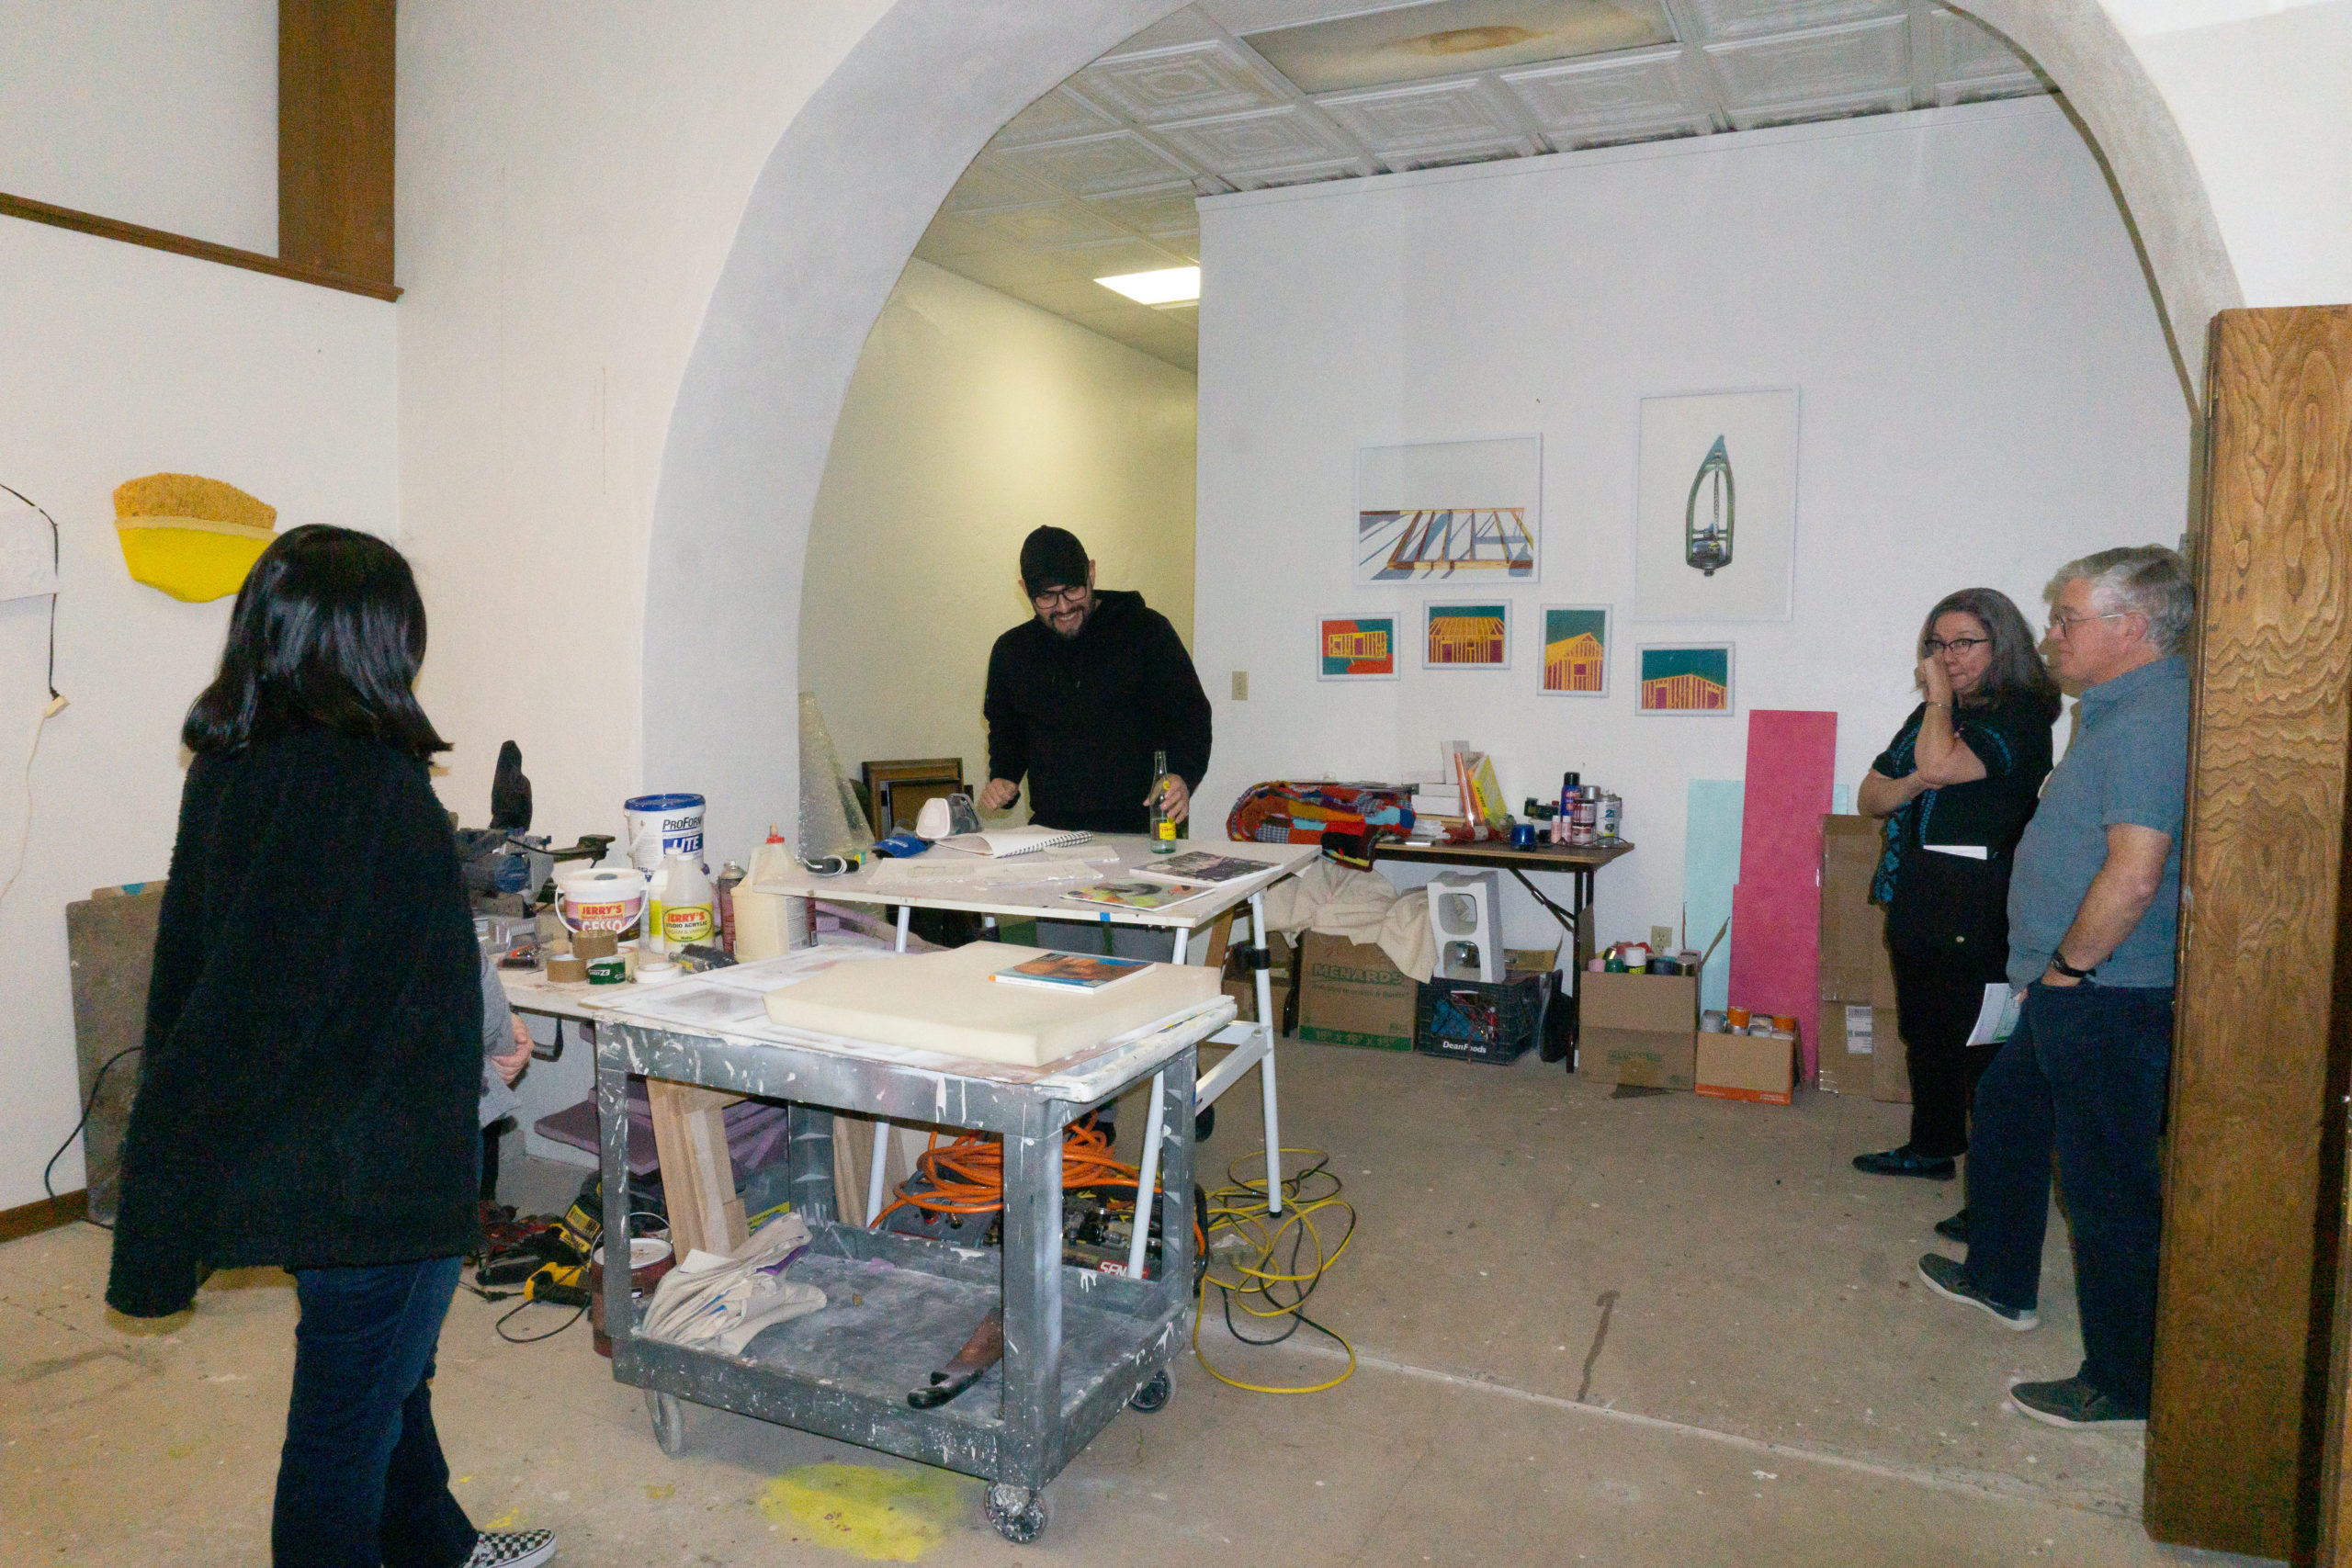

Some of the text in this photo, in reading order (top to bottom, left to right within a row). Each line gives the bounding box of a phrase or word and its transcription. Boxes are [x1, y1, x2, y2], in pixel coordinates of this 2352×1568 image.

[582, 905, 623, 915] JERRY'S
[667, 911, 705, 922] JERRY'S
[1101, 1262, 1129, 1279] SEN
